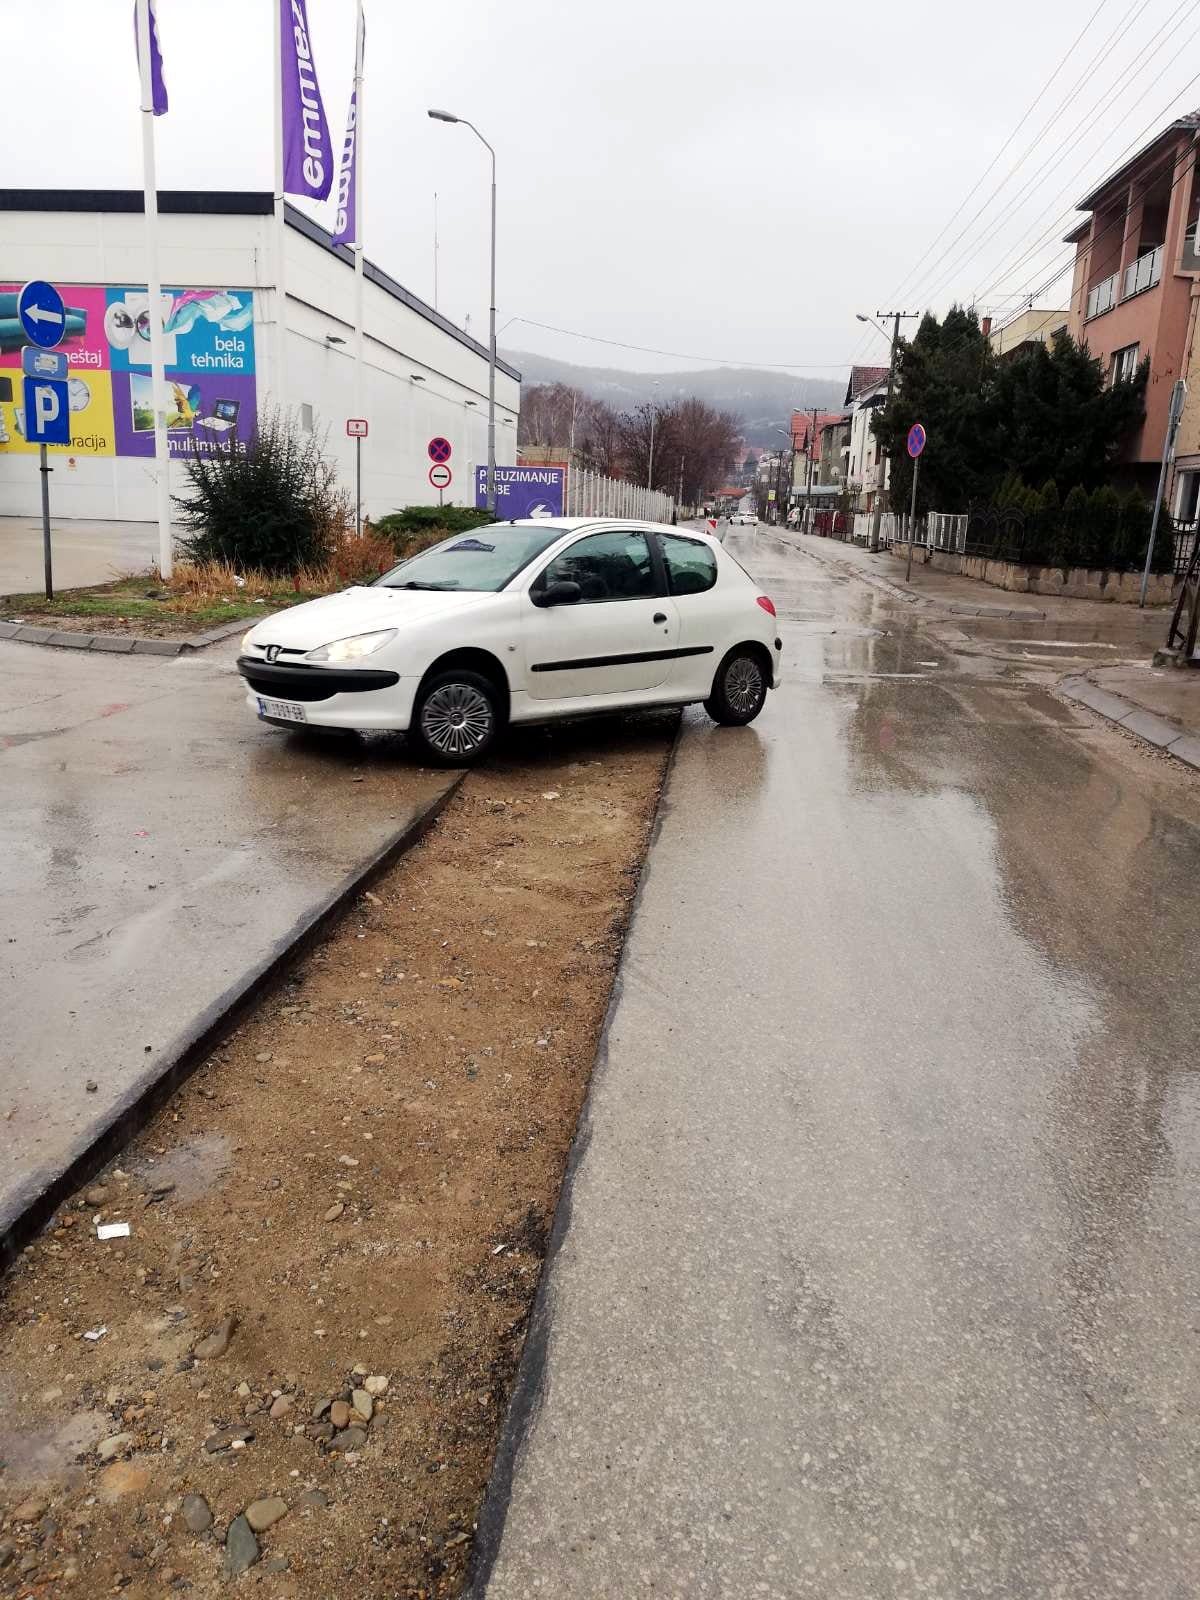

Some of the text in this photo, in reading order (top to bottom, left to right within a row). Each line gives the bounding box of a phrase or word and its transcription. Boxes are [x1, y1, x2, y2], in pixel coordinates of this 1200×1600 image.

[214, 336, 245, 352] bela
[191, 353, 244, 368] tehnika
[35, 387, 59, 434] P
[480, 469, 559, 485] PEUZIMANJE
[480, 484, 511, 495] RBE
